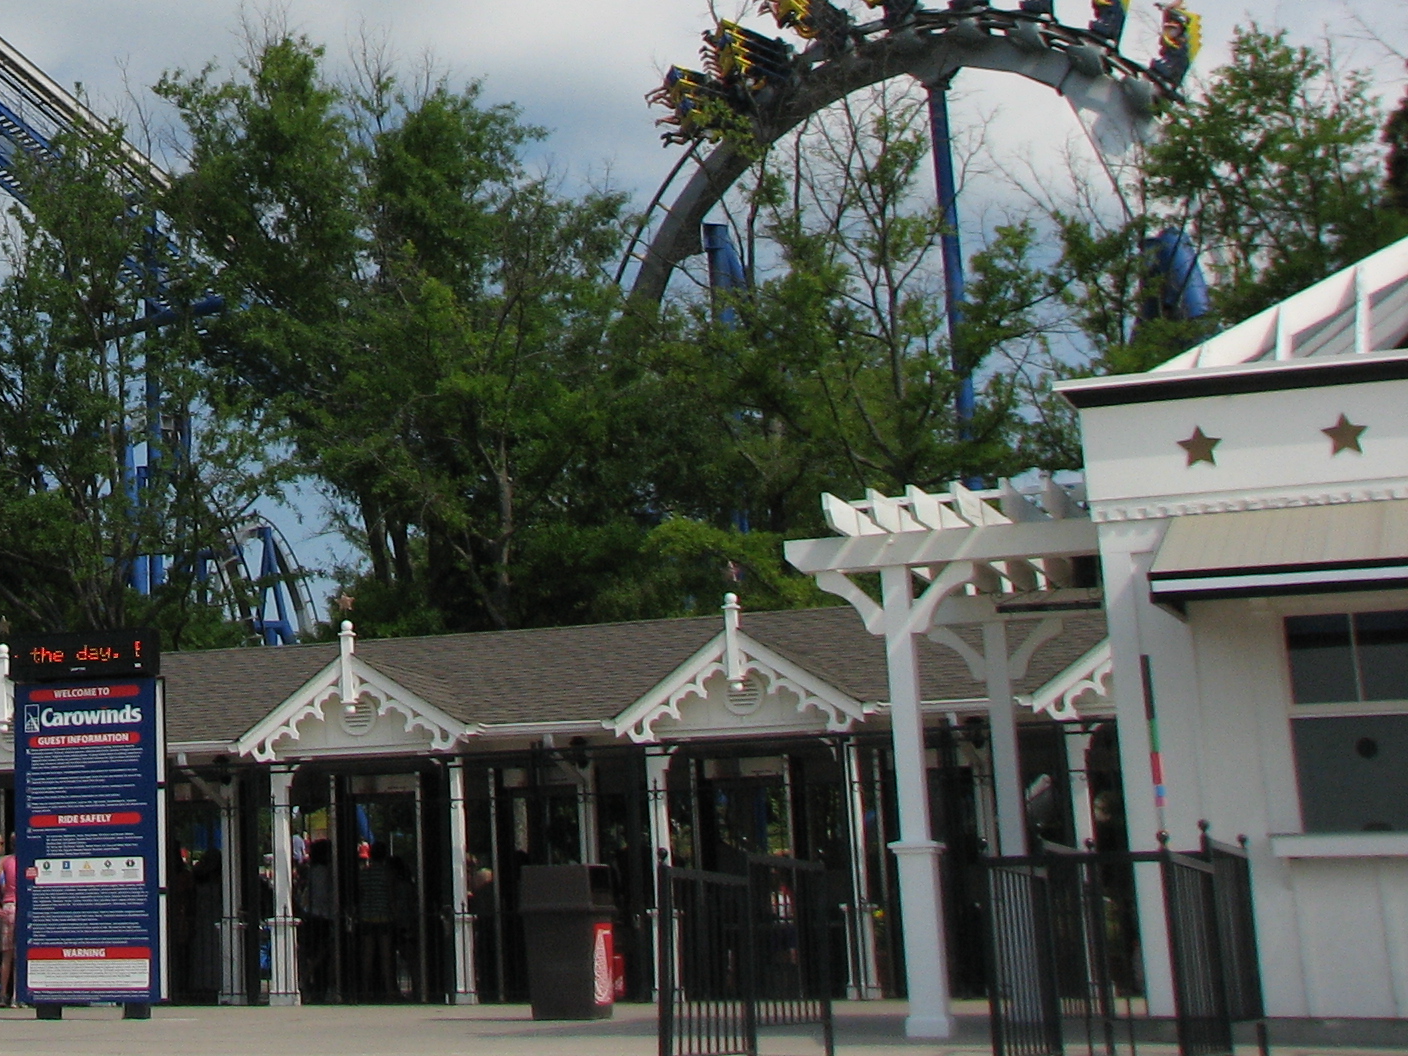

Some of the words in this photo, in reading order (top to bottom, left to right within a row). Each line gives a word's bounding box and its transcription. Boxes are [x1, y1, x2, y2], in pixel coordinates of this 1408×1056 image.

[30, 647, 65, 663] the
[54, 688, 96, 699] WELCOME
[98, 687, 110, 696] TO
[40, 704, 142, 727] Carowinds
[38, 735, 66, 745] GUEST
[67, 733, 129, 744] INFORMATION
[58, 815, 78, 824] RIDE
[80, 813, 112, 823] SAFELY
[62, 948, 106, 958] WARNING
